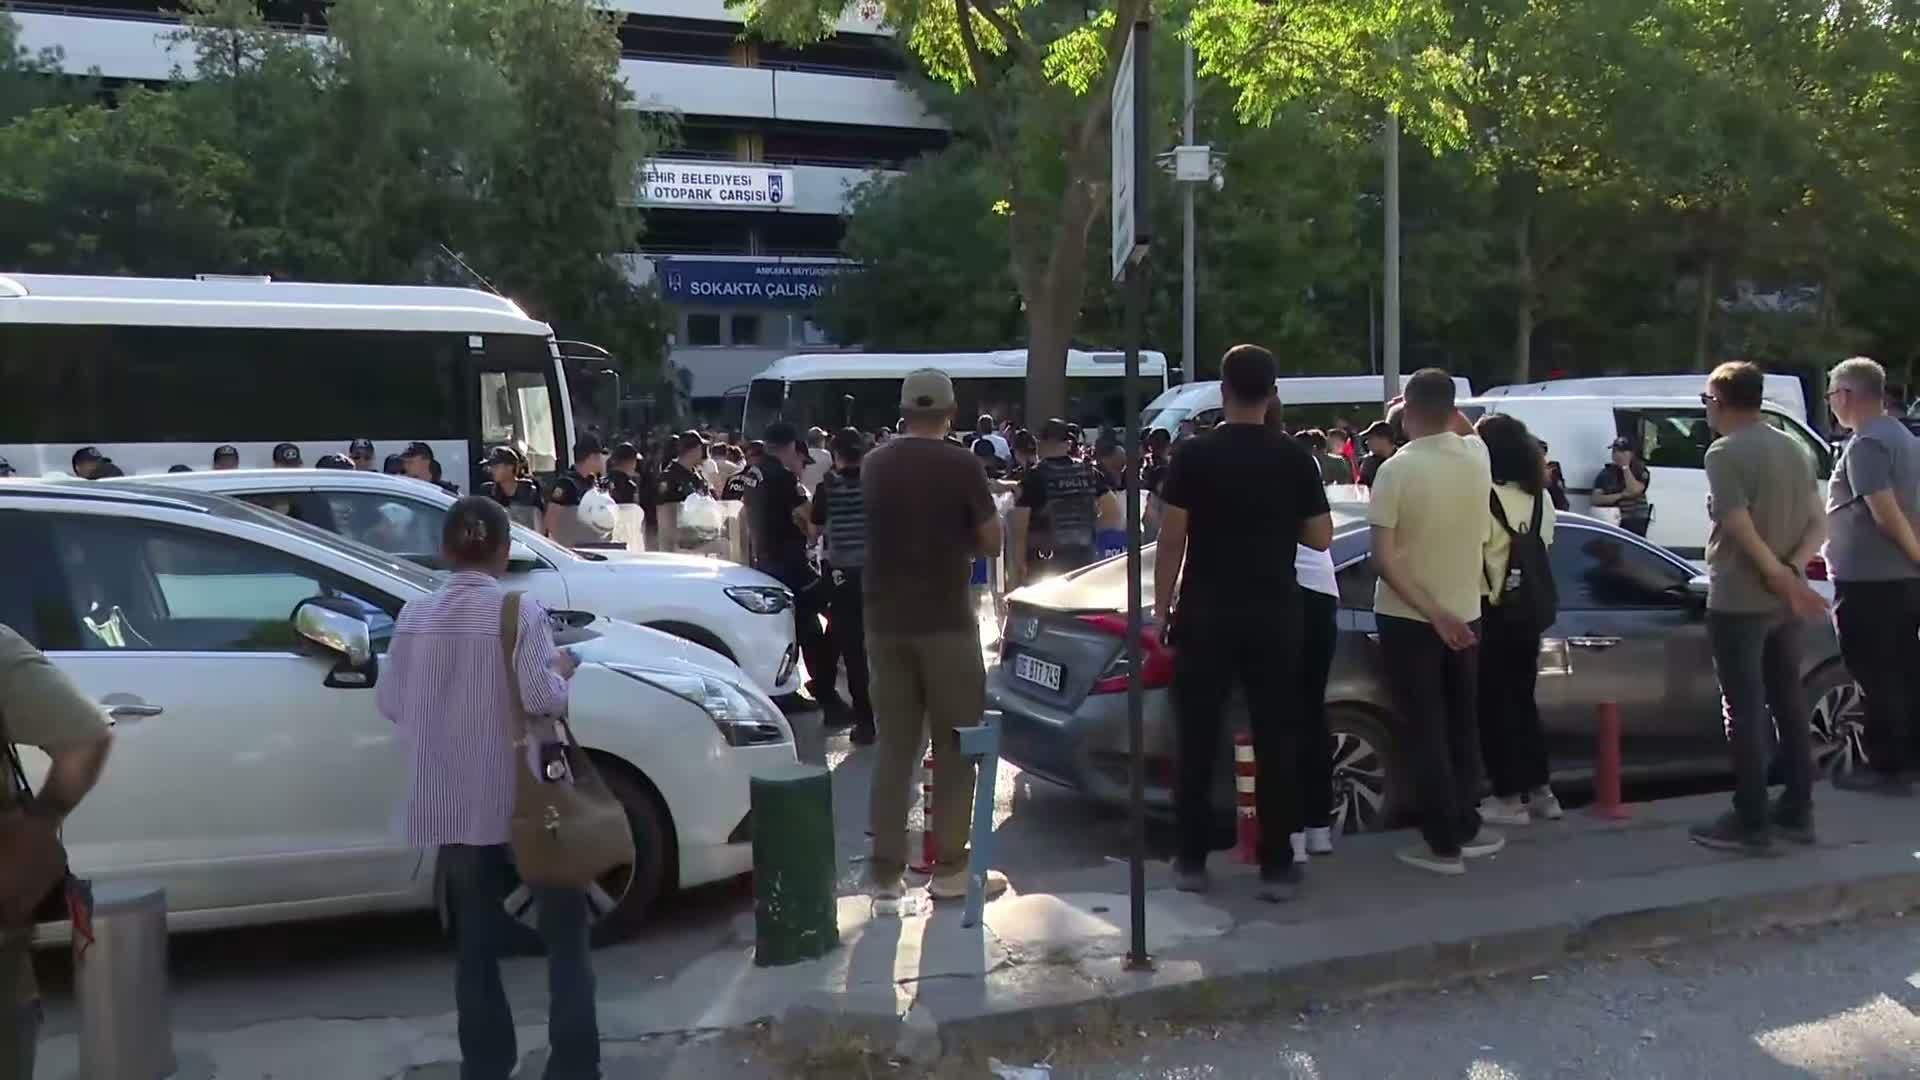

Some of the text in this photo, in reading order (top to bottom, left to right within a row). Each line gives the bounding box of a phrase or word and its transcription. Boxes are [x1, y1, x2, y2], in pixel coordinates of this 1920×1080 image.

[681, 173, 752, 186] BELEDİYESİ
[654, 186, 713, 199] OTOPARK
[690, 281, 761, 296] SOKAKTA
